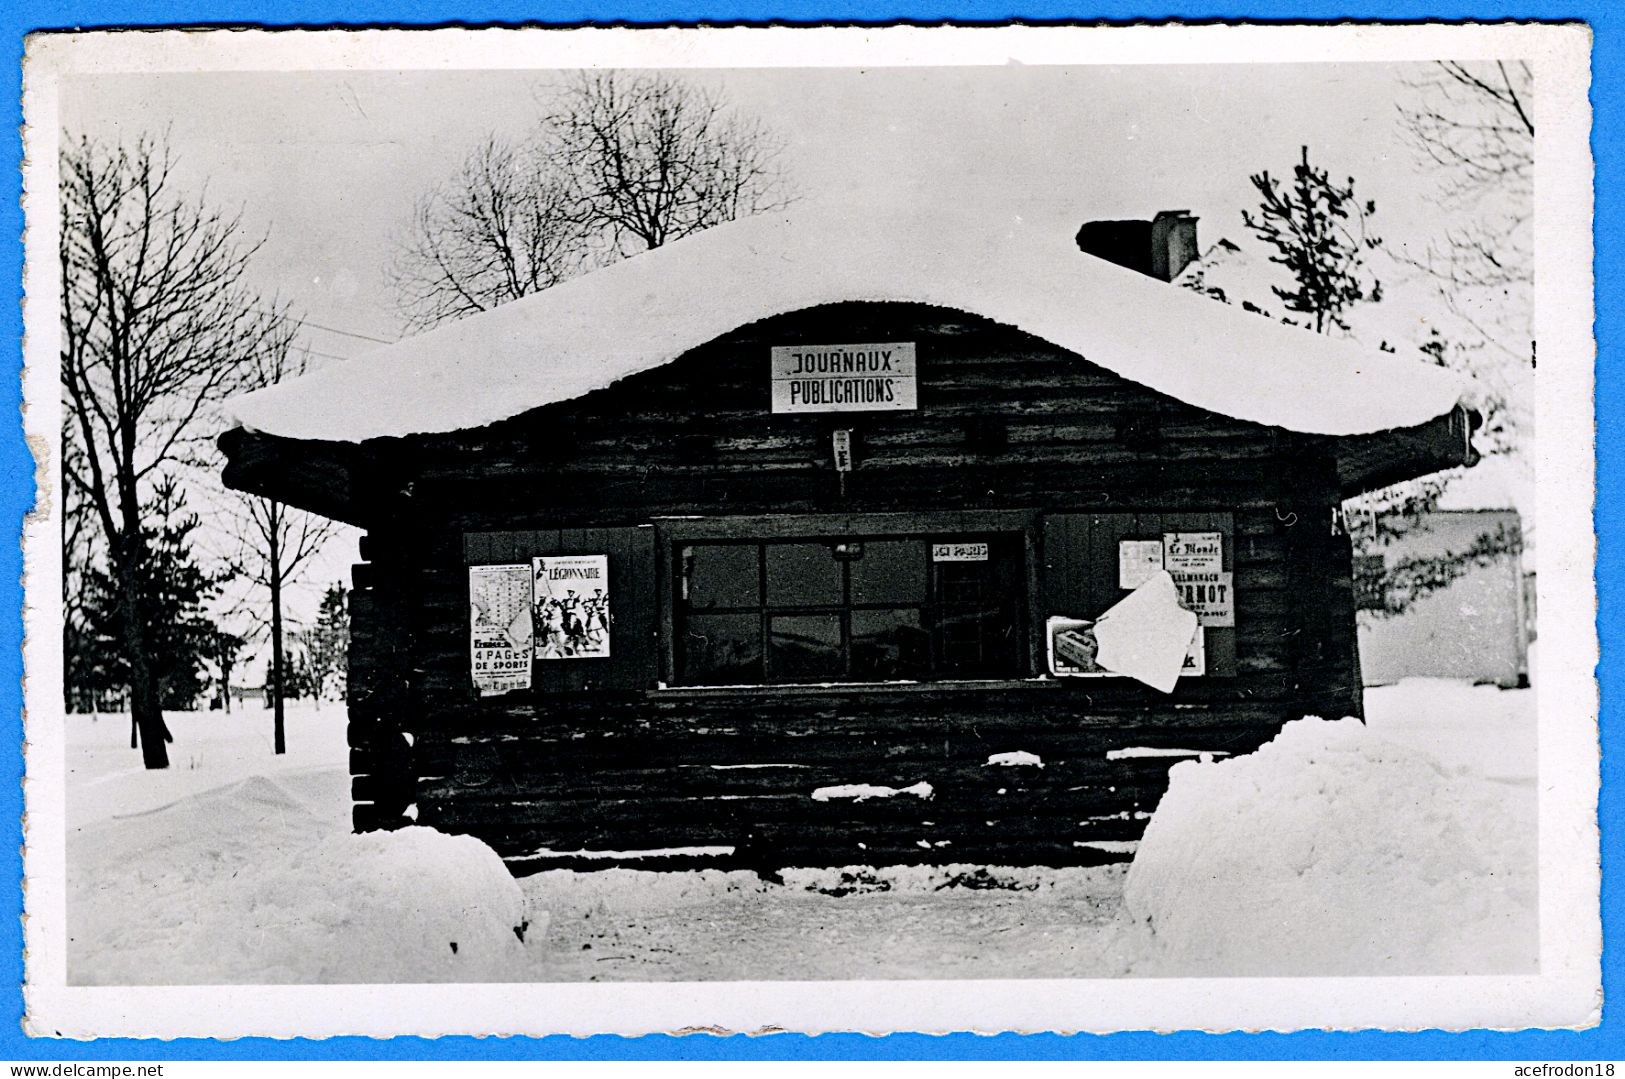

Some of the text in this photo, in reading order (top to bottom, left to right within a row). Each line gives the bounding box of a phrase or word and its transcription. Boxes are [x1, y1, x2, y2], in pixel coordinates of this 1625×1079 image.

[792, 351, 892, 374] JOURNAUX
[791, 378, 894, 405] PUBLICATIONS
[1184, 543, 1218, 555] Monde
[549, 566, 601, 580] LÉGIONNAIRE
[475, 649, 529, 660] 4 PAGES
[475, 661, 528, 670] DE SPORTS
